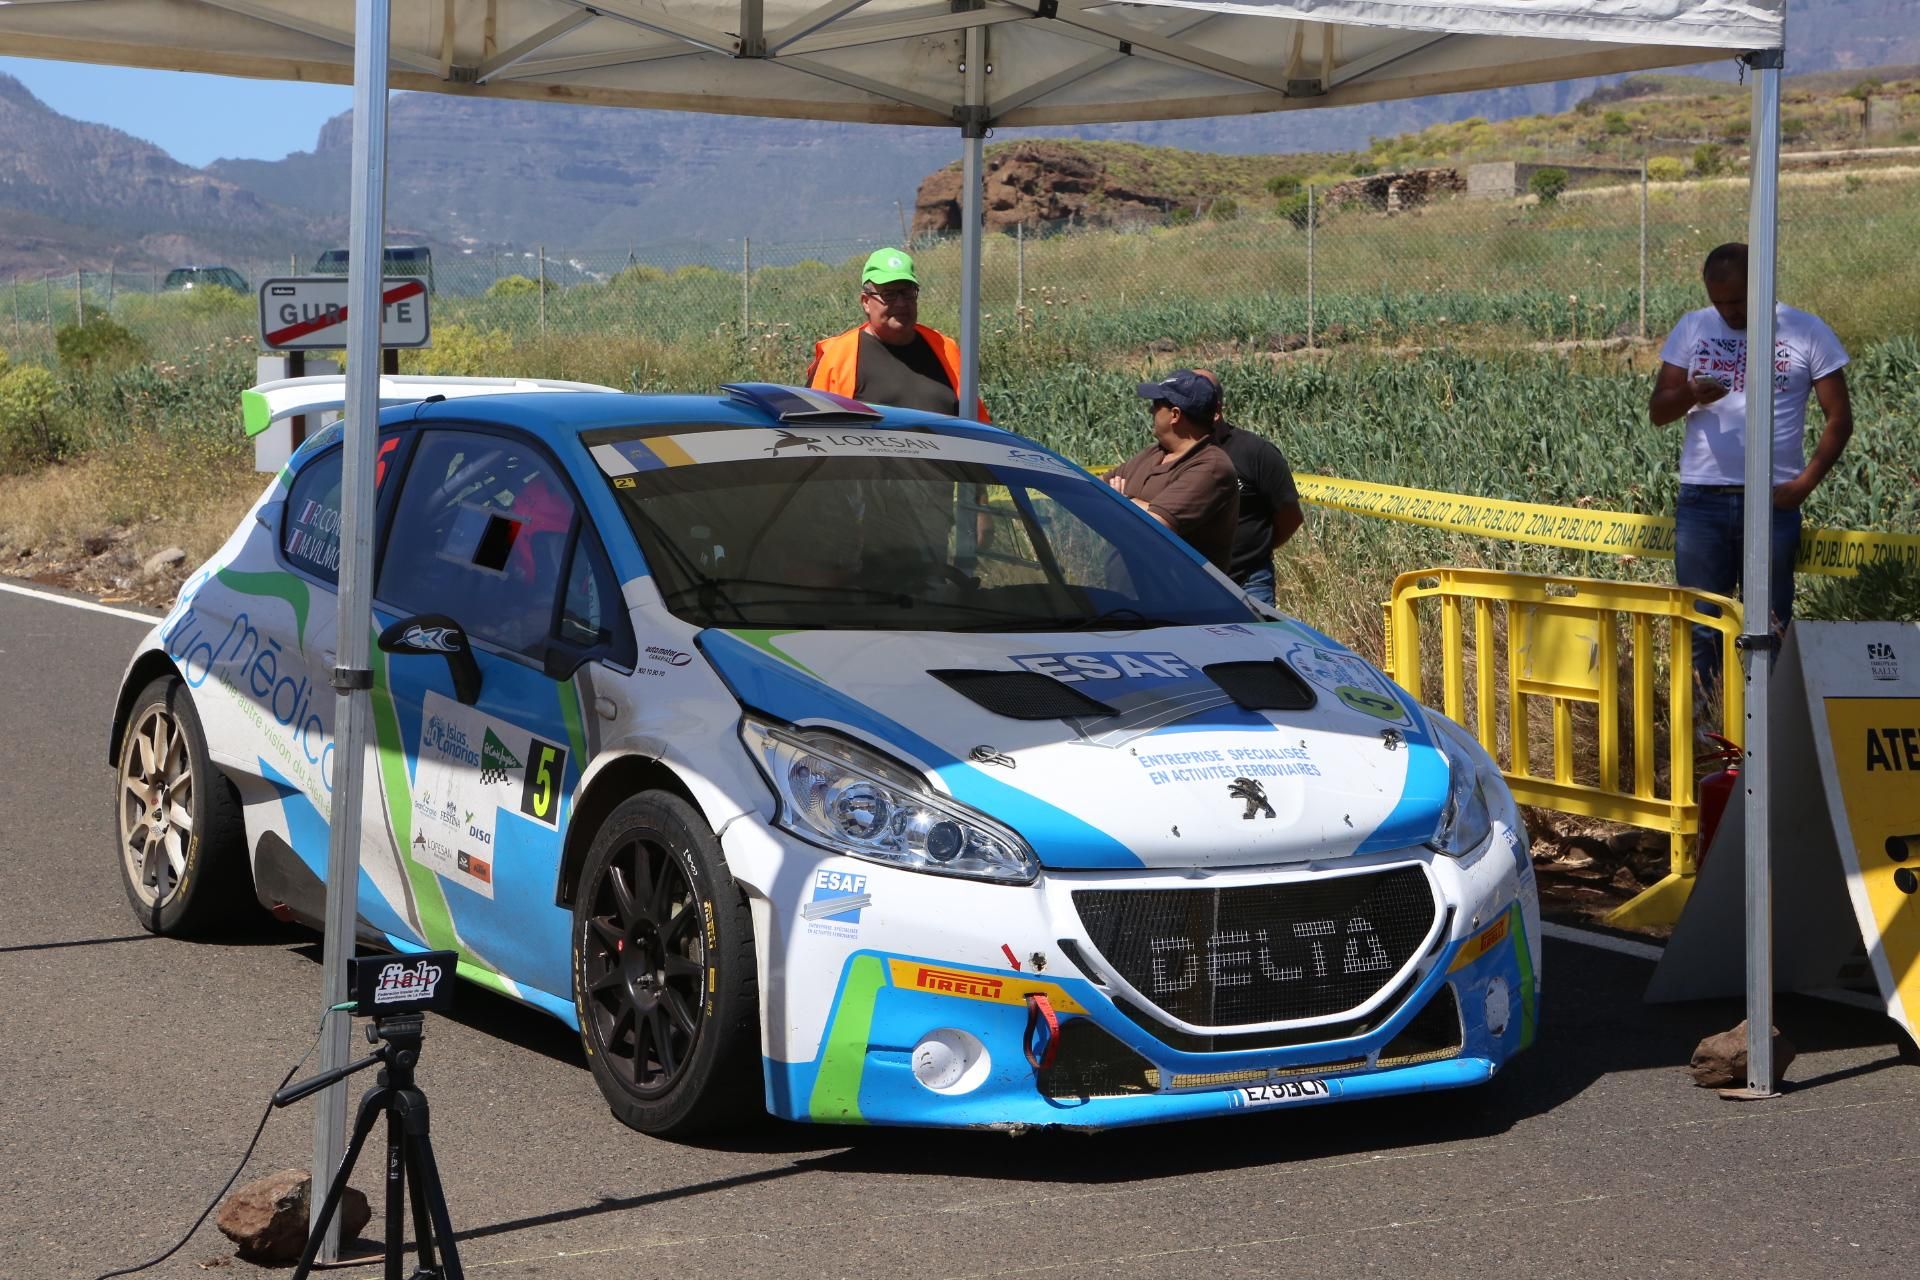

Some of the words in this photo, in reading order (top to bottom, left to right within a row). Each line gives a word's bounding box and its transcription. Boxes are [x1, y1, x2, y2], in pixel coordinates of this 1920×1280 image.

[279, 303, 412, 325] GURTE
[826, 435, 941, 451] LOPESAN
[310, 504, 341, 536] R.CON
[1315, 485, 1346, 505] ZONA
[1343, 489, 1383, 511] PUBLICO
[1380, 494, 1411, 516] ZONA
[1407, 498, 1452, 522] PUBLICO
[1450, 504, 1482, 527] ZONA
[1478, 508, 1525, 533] PUBLICO
[1525, 513, 1557, 537] ZONA
[1553, 516, 1602, 543] PUBLICO
[1603, 522, 1636, 547] ZONA
[1633, 525, 1677, 552] PUBLIC
[1814, 541, 1864, 568] PUBLICO
[297, 533, 340, 571] M.VILMO
[1017, 654, 1189, 682] ESAF
[1871, 667, 1898, 675] RALLY
[238, 696, 263, 729] autre
[264, 723, 292, 765] vision
[292, 758, 305, 780] du
[446, 722, 467, 748] Islas
[437, 739, 480, 768] Canarias
[1138, 750, 1225, 768] ENTREPRISE
[1227, 746, 1311, 761] SPÉCIALISÉE
[1866, 728, 1920, 772] ATE
[533, 746, 556, 818] 5
[1149, 770, 1171, 785] EN
[1171, 765, 1237, 783] ACTIVITÉS
[1235, 763, 1322, 777] FERROVIAIRES
[440, 810, 461, 829] FESTINA
[816, 871, 866, 894] ESAF
[1151, 917, 1392, 993] DELTA
[378, 961, 440, 992] fialp
[916, 968, 1004, 999] PIRELLI
